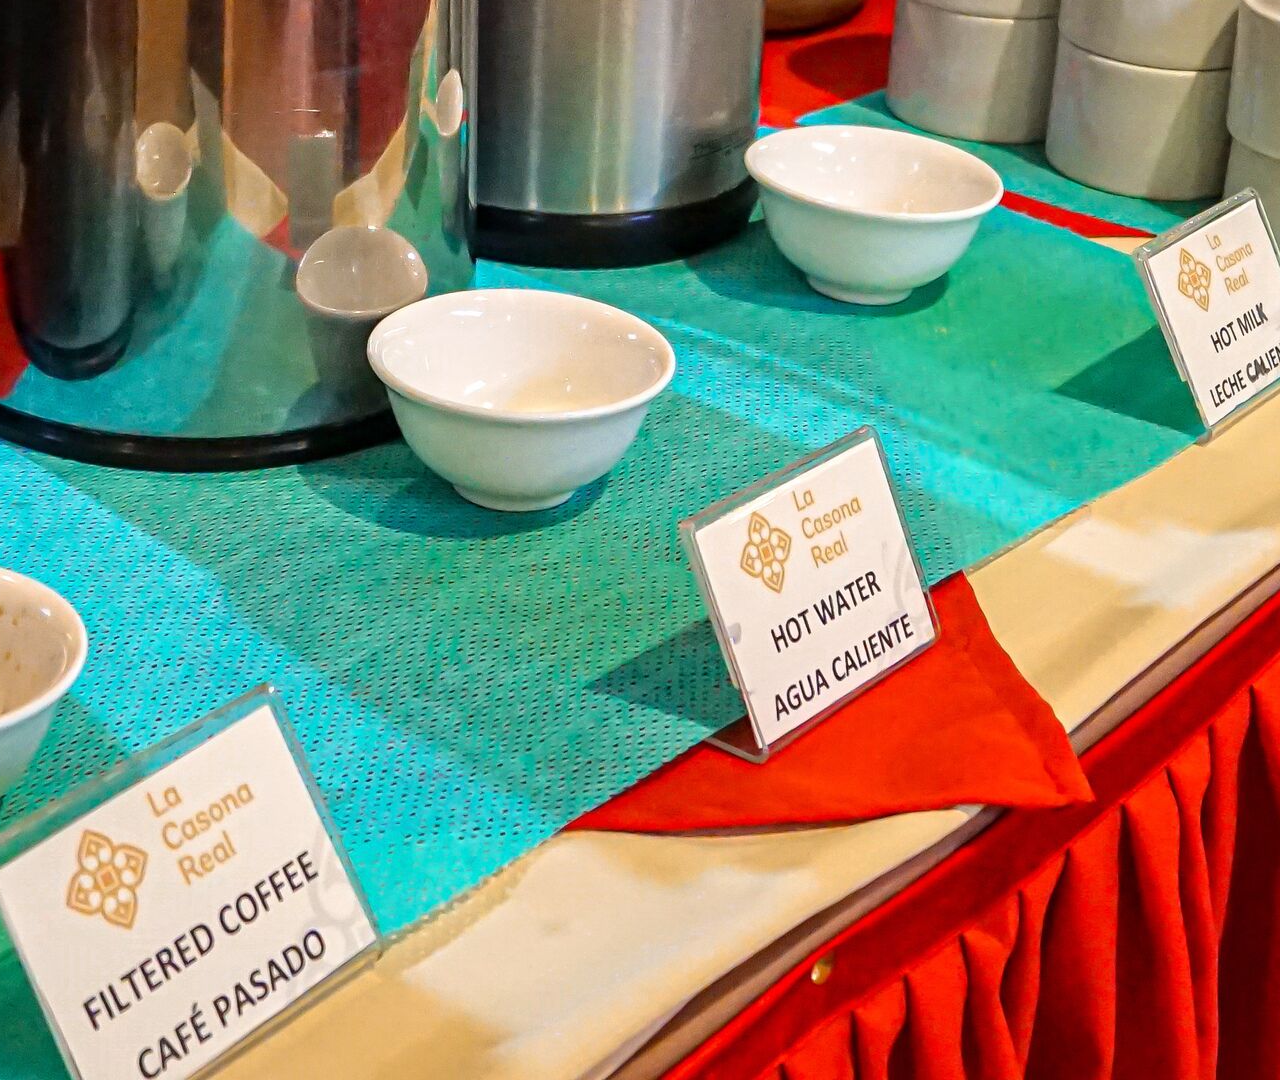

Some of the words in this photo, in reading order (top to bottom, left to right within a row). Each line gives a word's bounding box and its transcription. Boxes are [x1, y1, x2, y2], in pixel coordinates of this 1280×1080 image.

[1205, 234, 1221, 250] La
[1215, 242, 1253, 271] Casona
[1224, 269, 1249, 295] Real
[1210, 322, 1238, 354] HOT
[1238, 302, 1269, 337] MILK
[1209, 369, 1247, 408] LECHE
[791, 487, 815, 512] La
[801, 495, 862, 539] Casona
[811, 531, 849, 569] Real
[770, 609, 812, 654] HOT
[812, 570, 882, 626] WATER
[774, 668, 830, 721] AGUA
[831, 613, 915, 682] CALIENTE
[145, 782, 183, 819] La
[161, 782, 254, 852] Casona
[177, 834, 238, 886] Real
[82, 922, 217, 1031] FILTERED
[217, 851, 321, 936] COFFEE
[138, 1004, 215, 1080] CAFÉ
[214, 929, 326, 1028] PASADO
